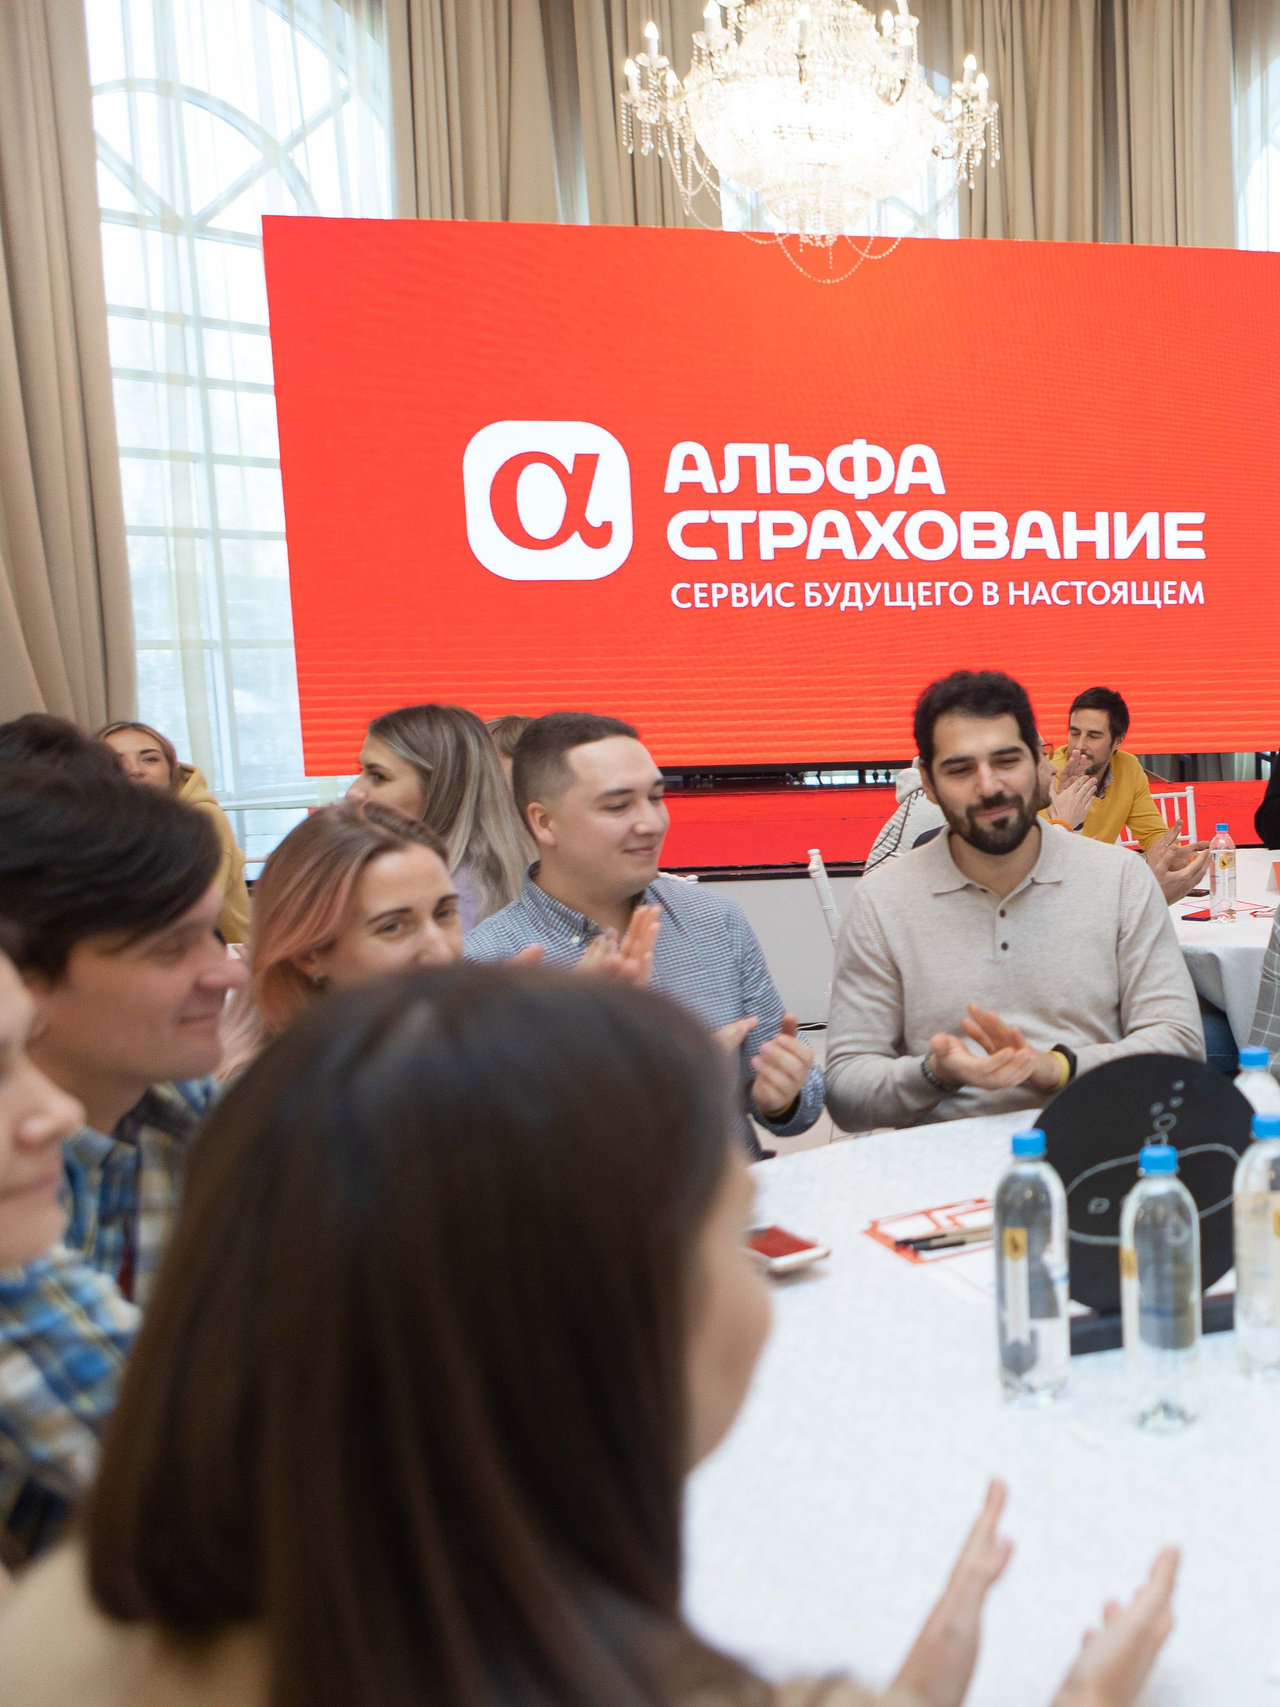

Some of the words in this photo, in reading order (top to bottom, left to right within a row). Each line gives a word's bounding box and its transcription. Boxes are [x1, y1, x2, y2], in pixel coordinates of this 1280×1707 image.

[663, 438, 947, 500] АЛЬФА
[666, 508, 1207, 561] СТРАХОВАНИЕ
[670, 582, 796, 609] СЕРВИС
[804, 581, 974, 612] БУДУЩЕГО
[981, 580, 1000, 607] В
[1008, 580, 1205, 610] НАСТОЯЩЕМ
